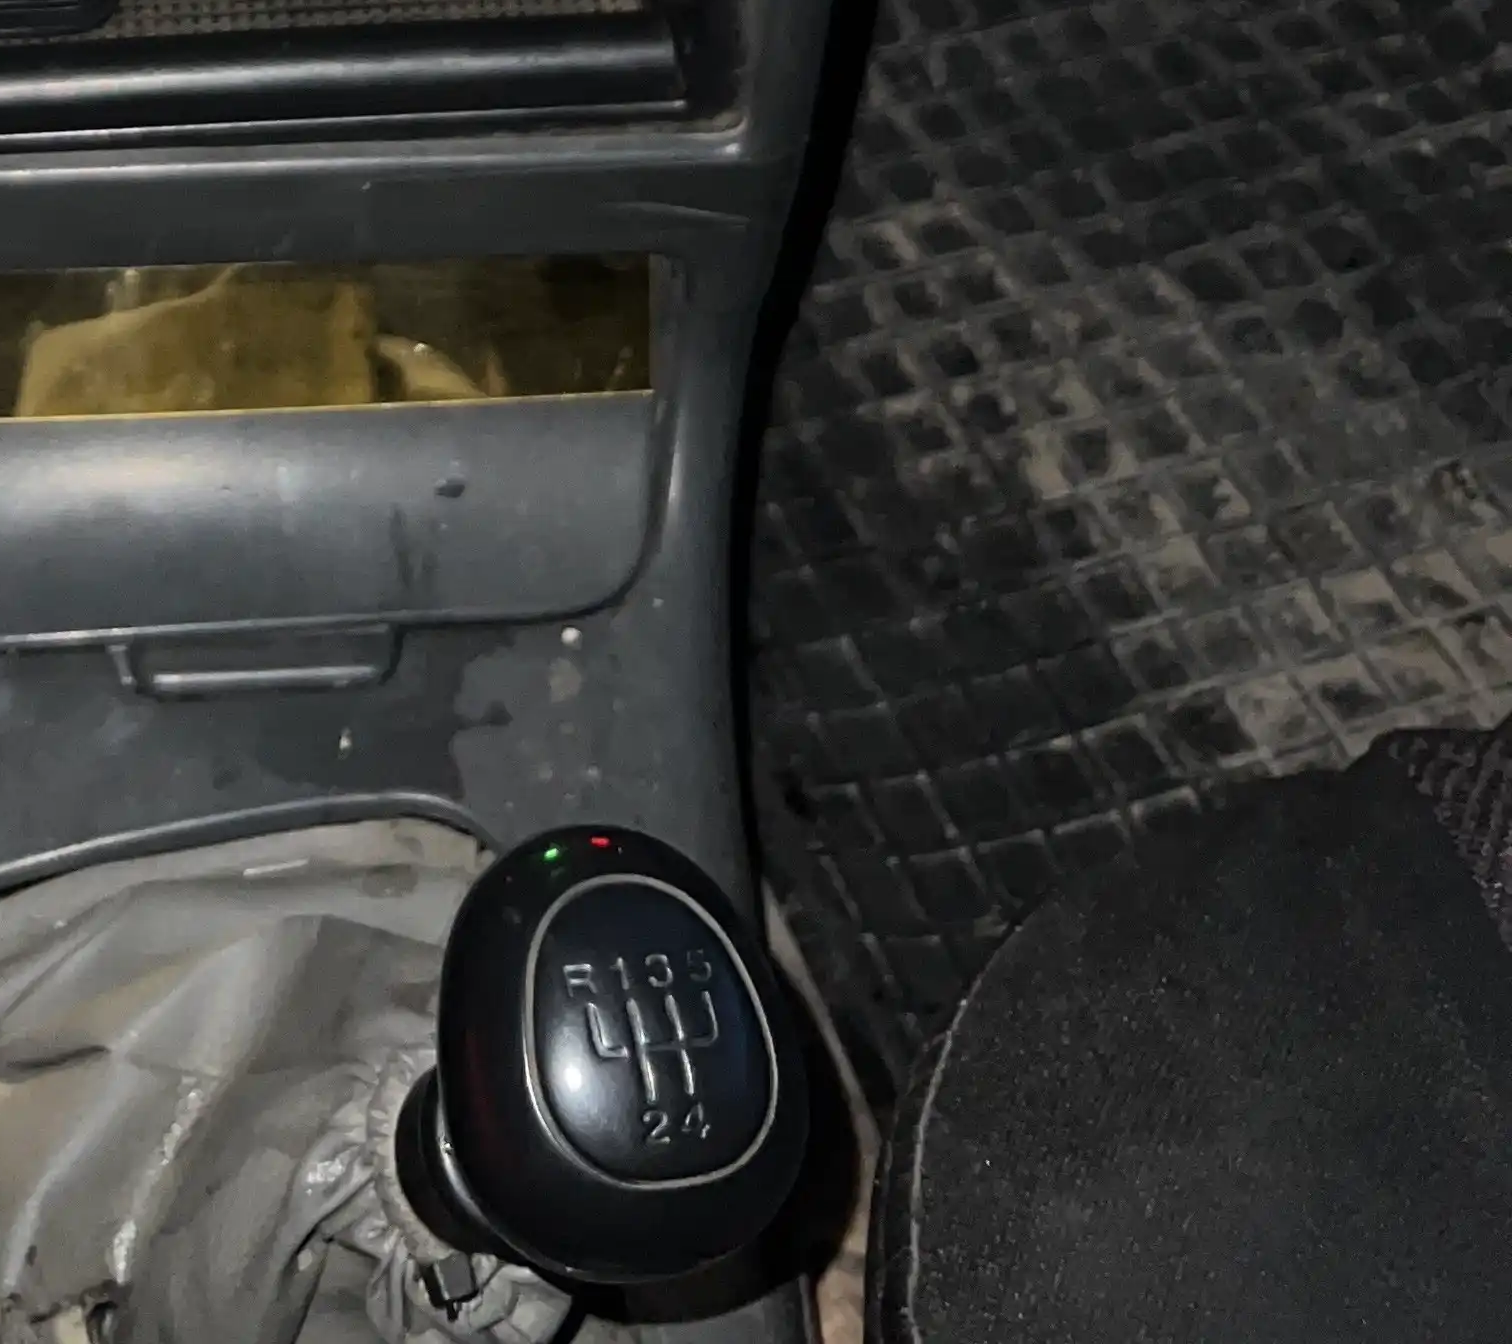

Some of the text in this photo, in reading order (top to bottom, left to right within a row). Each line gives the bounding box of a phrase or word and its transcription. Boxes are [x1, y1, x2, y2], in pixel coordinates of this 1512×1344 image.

[562, 949, 712, 998] R 1 3 5
[643, 1102, 711, 1144] 2 4
